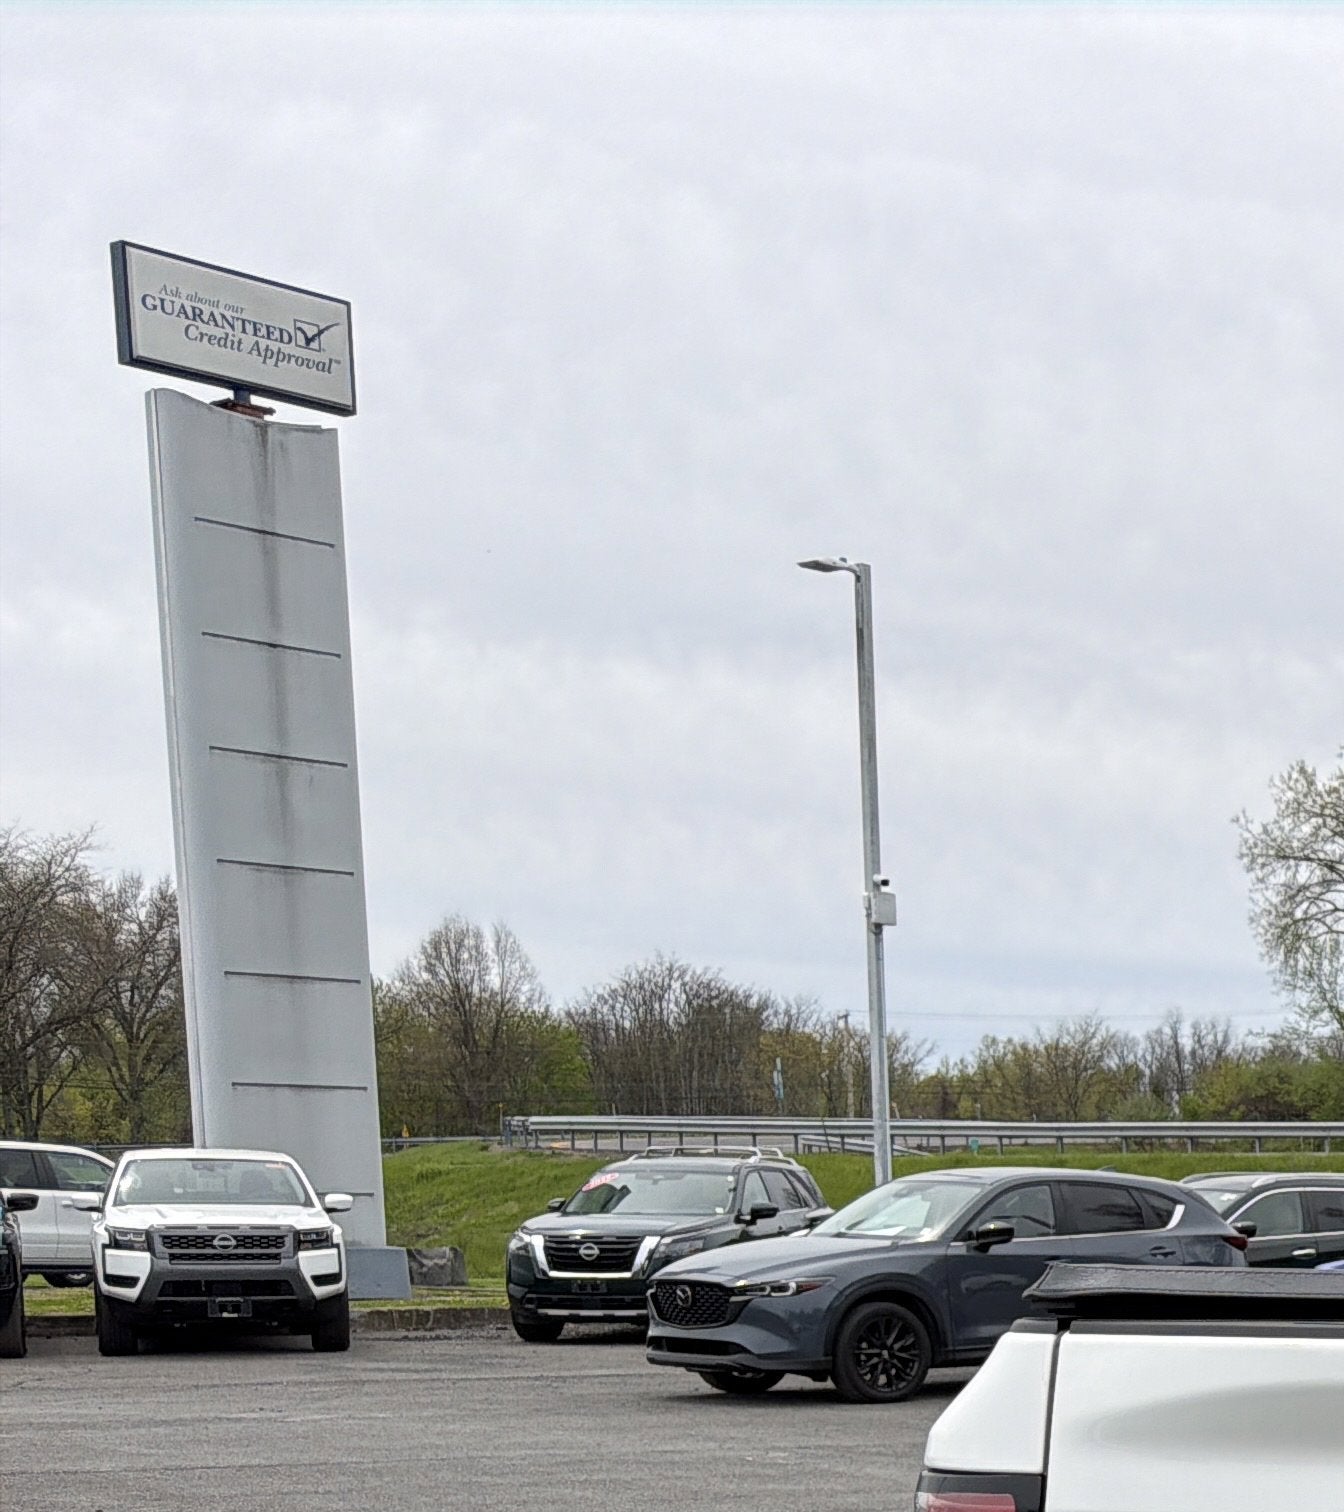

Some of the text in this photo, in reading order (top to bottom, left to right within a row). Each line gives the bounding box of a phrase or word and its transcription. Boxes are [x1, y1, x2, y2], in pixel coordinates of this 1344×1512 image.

[158, 283, 246, 314] Ask about our
[140, 293, 293, 345] GUARANTEED
[184, 323, 243, 353] Credit
